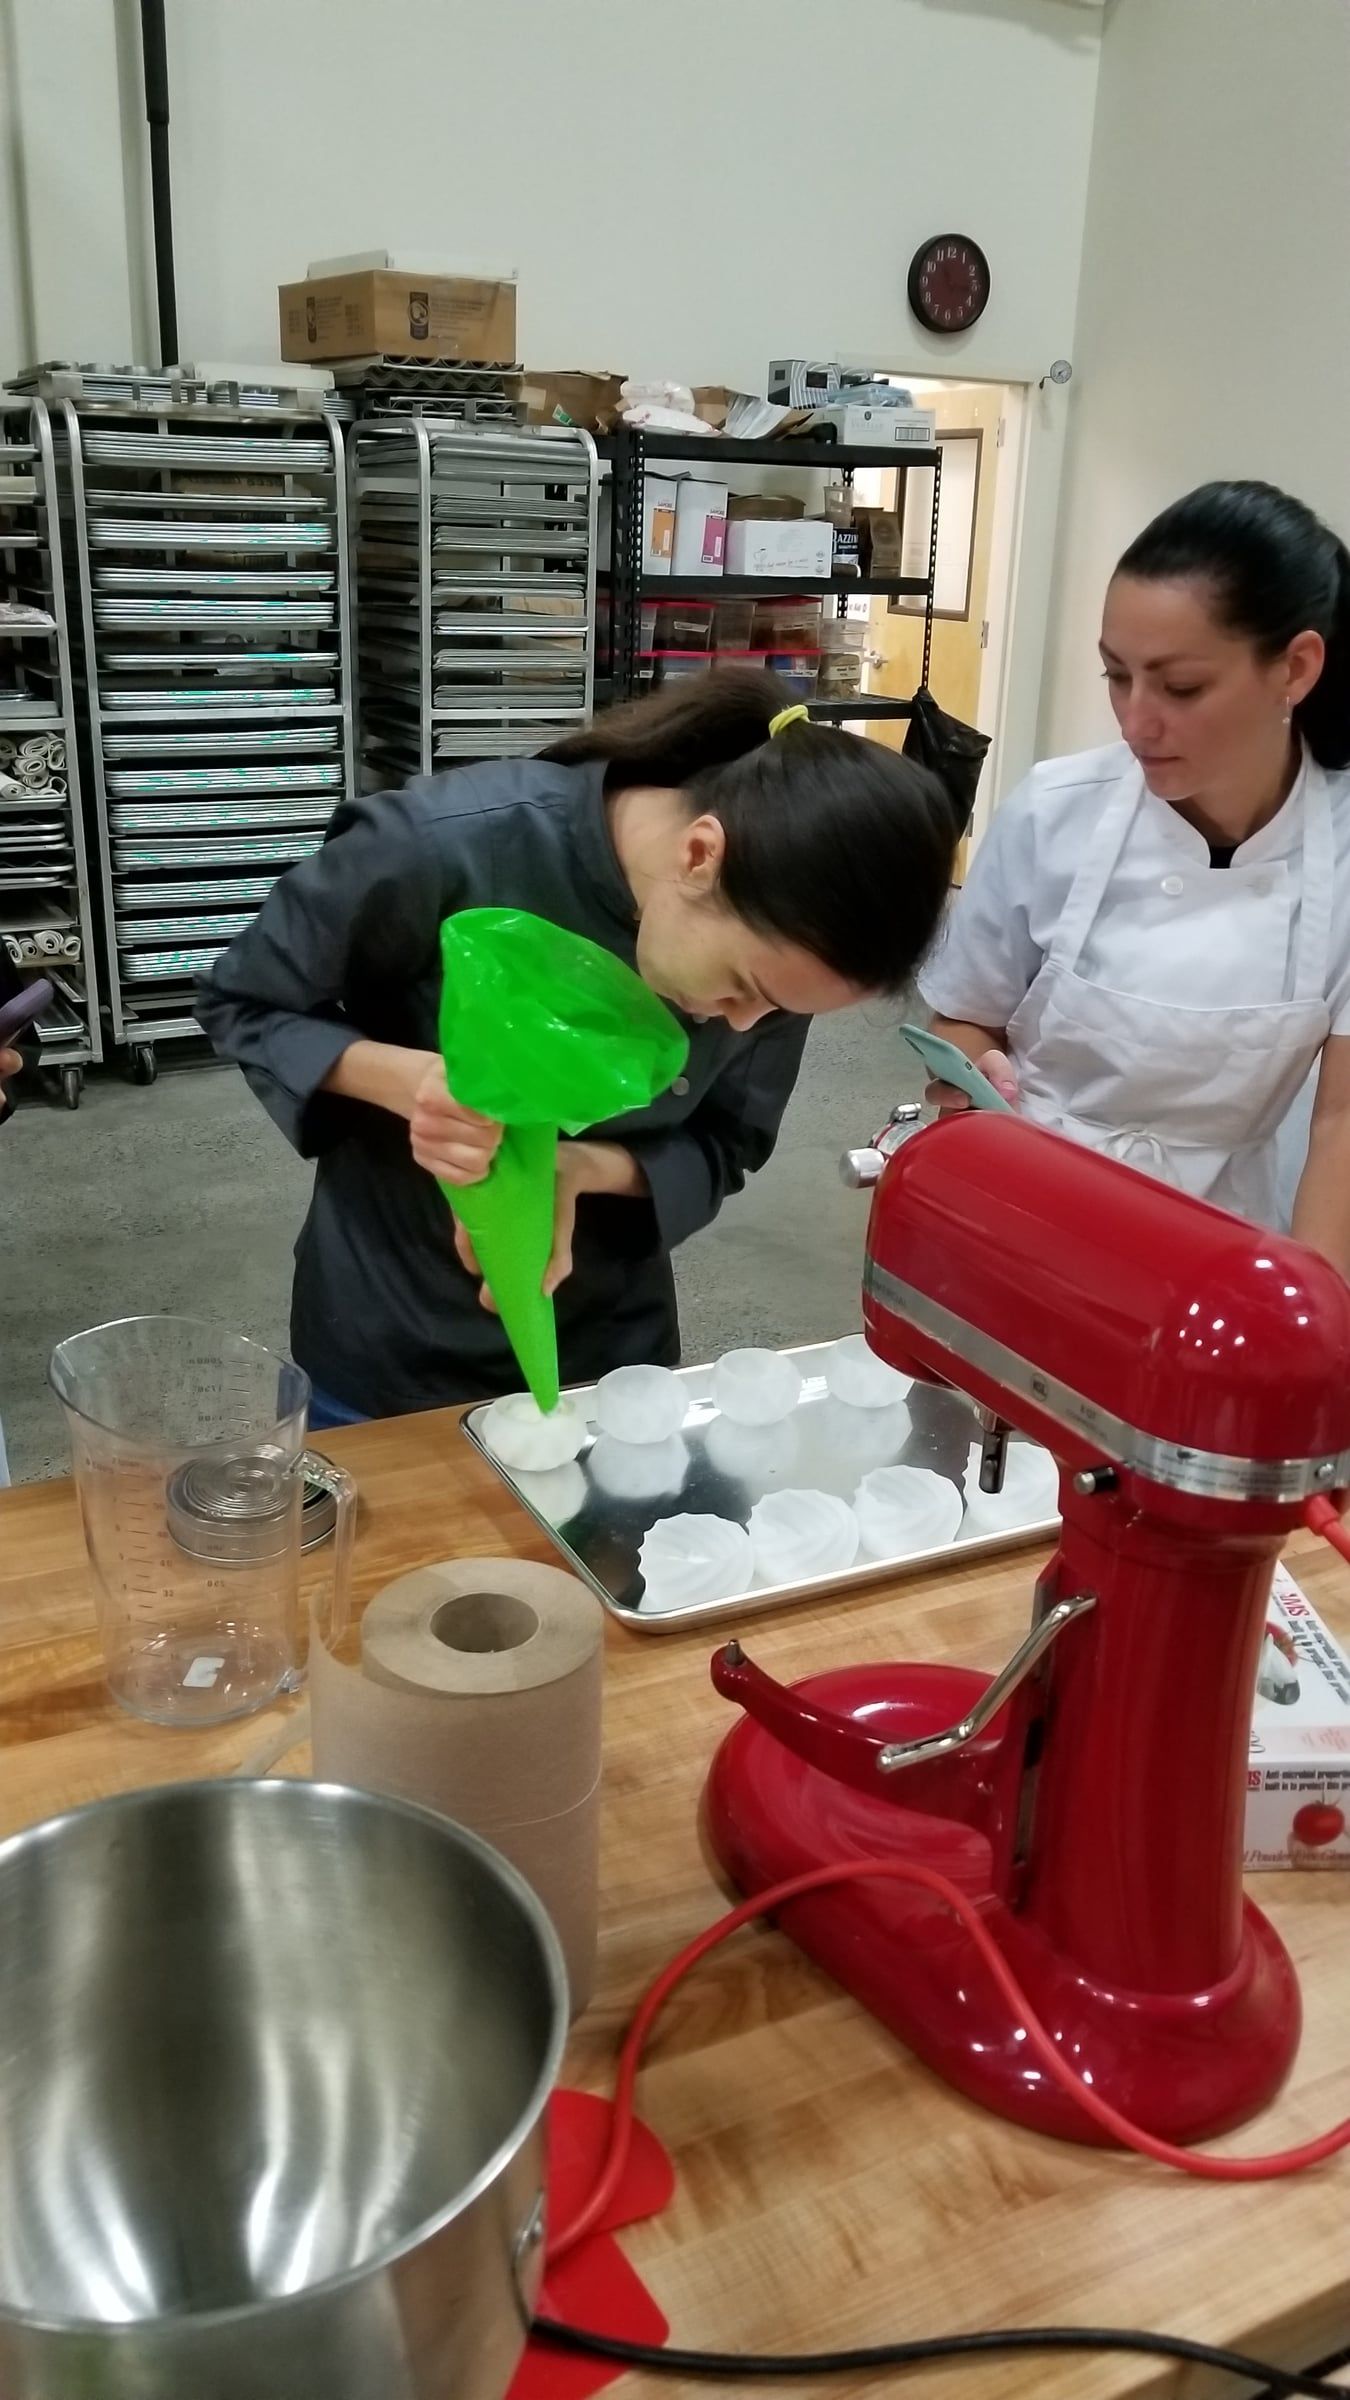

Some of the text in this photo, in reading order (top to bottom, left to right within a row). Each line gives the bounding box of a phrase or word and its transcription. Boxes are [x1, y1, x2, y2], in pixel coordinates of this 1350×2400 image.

[937, 249, 944, 261] 11
[947, 246, 957, 258] 12
[962, 251, 966, 264] 1
[927, 260, 937, 272] 10
[969, 264, 976, 276] 2
[922, 275, 929, 287] 9
[925, 291, 931, 303] 8
[966, 295, 972, 307] 4
[934, 303, 940, 315] 7
[944, 308, 951, 320] 6
